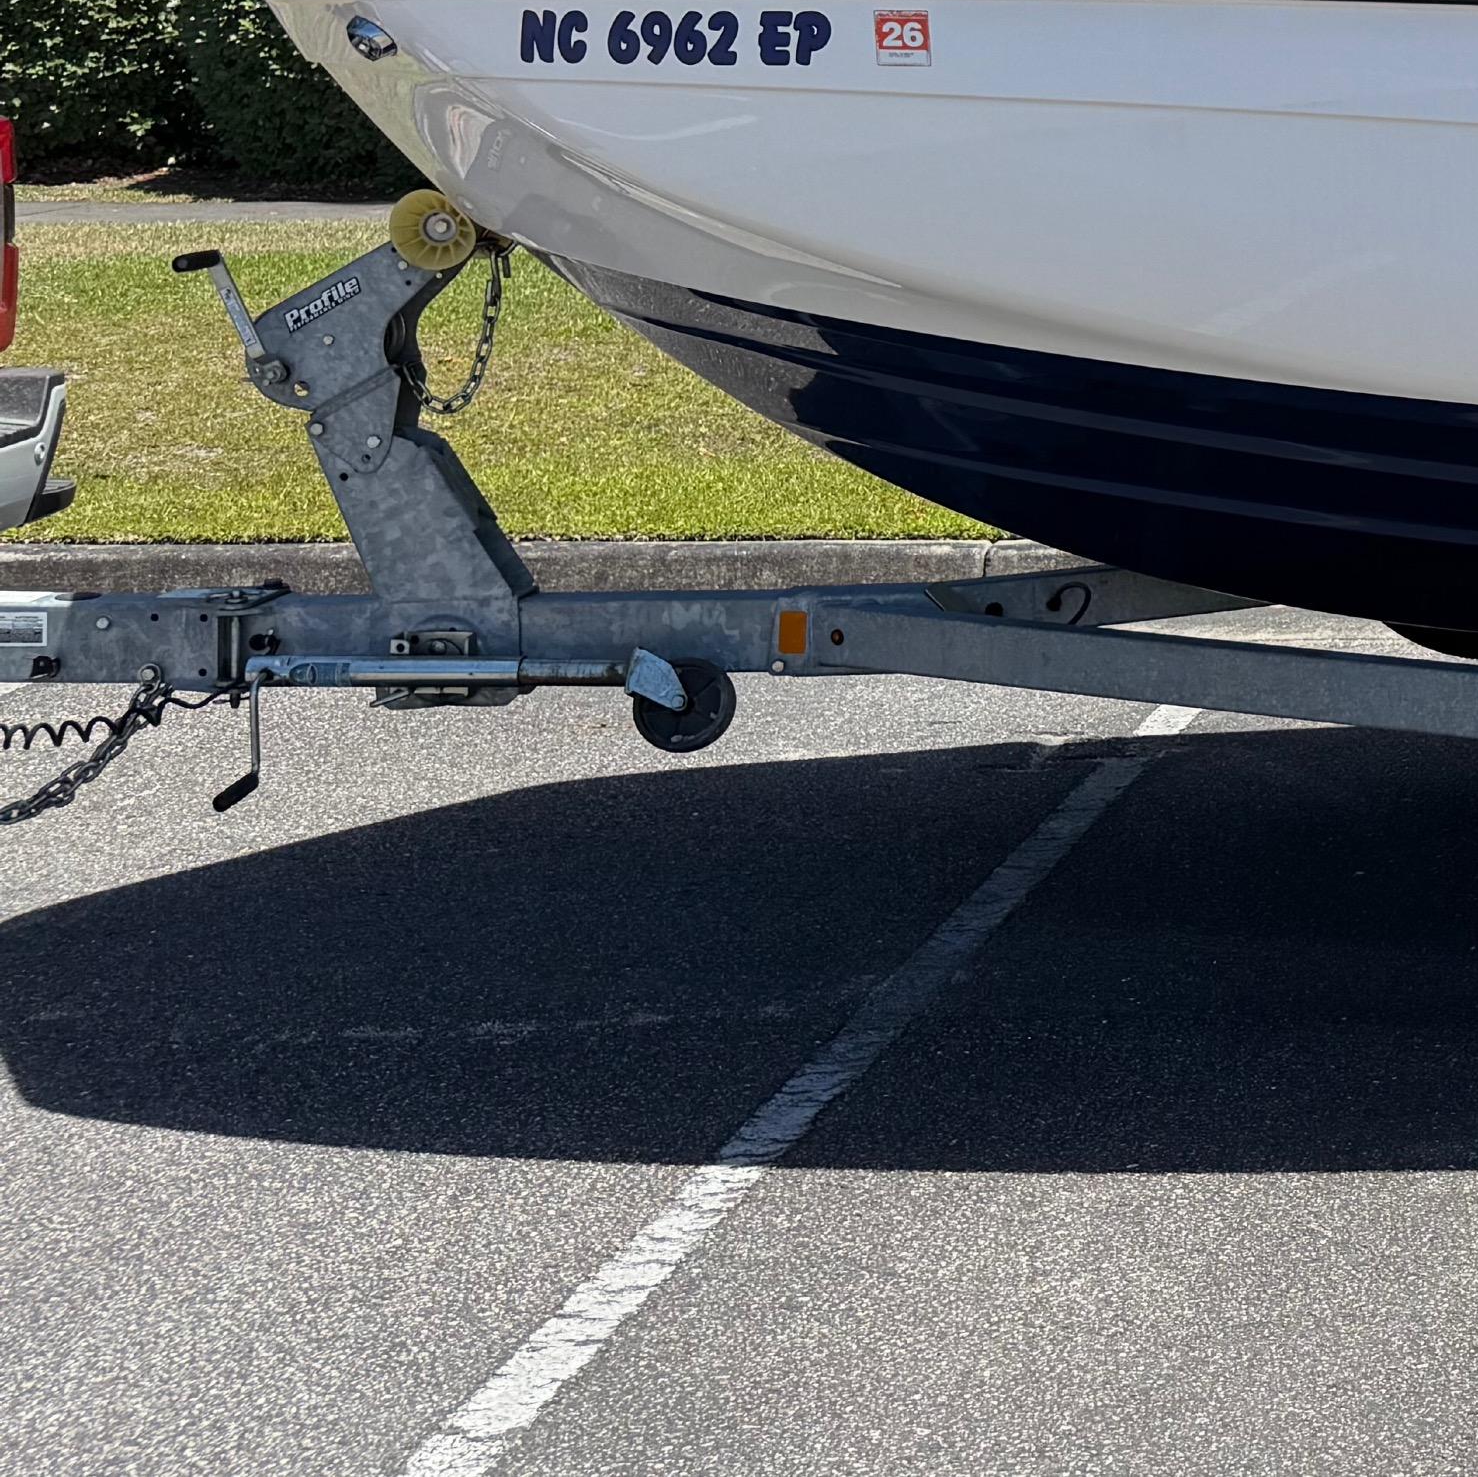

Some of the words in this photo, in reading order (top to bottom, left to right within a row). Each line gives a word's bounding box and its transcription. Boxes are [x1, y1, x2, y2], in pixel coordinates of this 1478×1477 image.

[520, 9, 588, 64] NC
[607, 10, 738, 65] 6962
[758, 10, 832, 66] EP
[881, 20, 923, 48] 26
[285, 278, 358, 328] Profile
